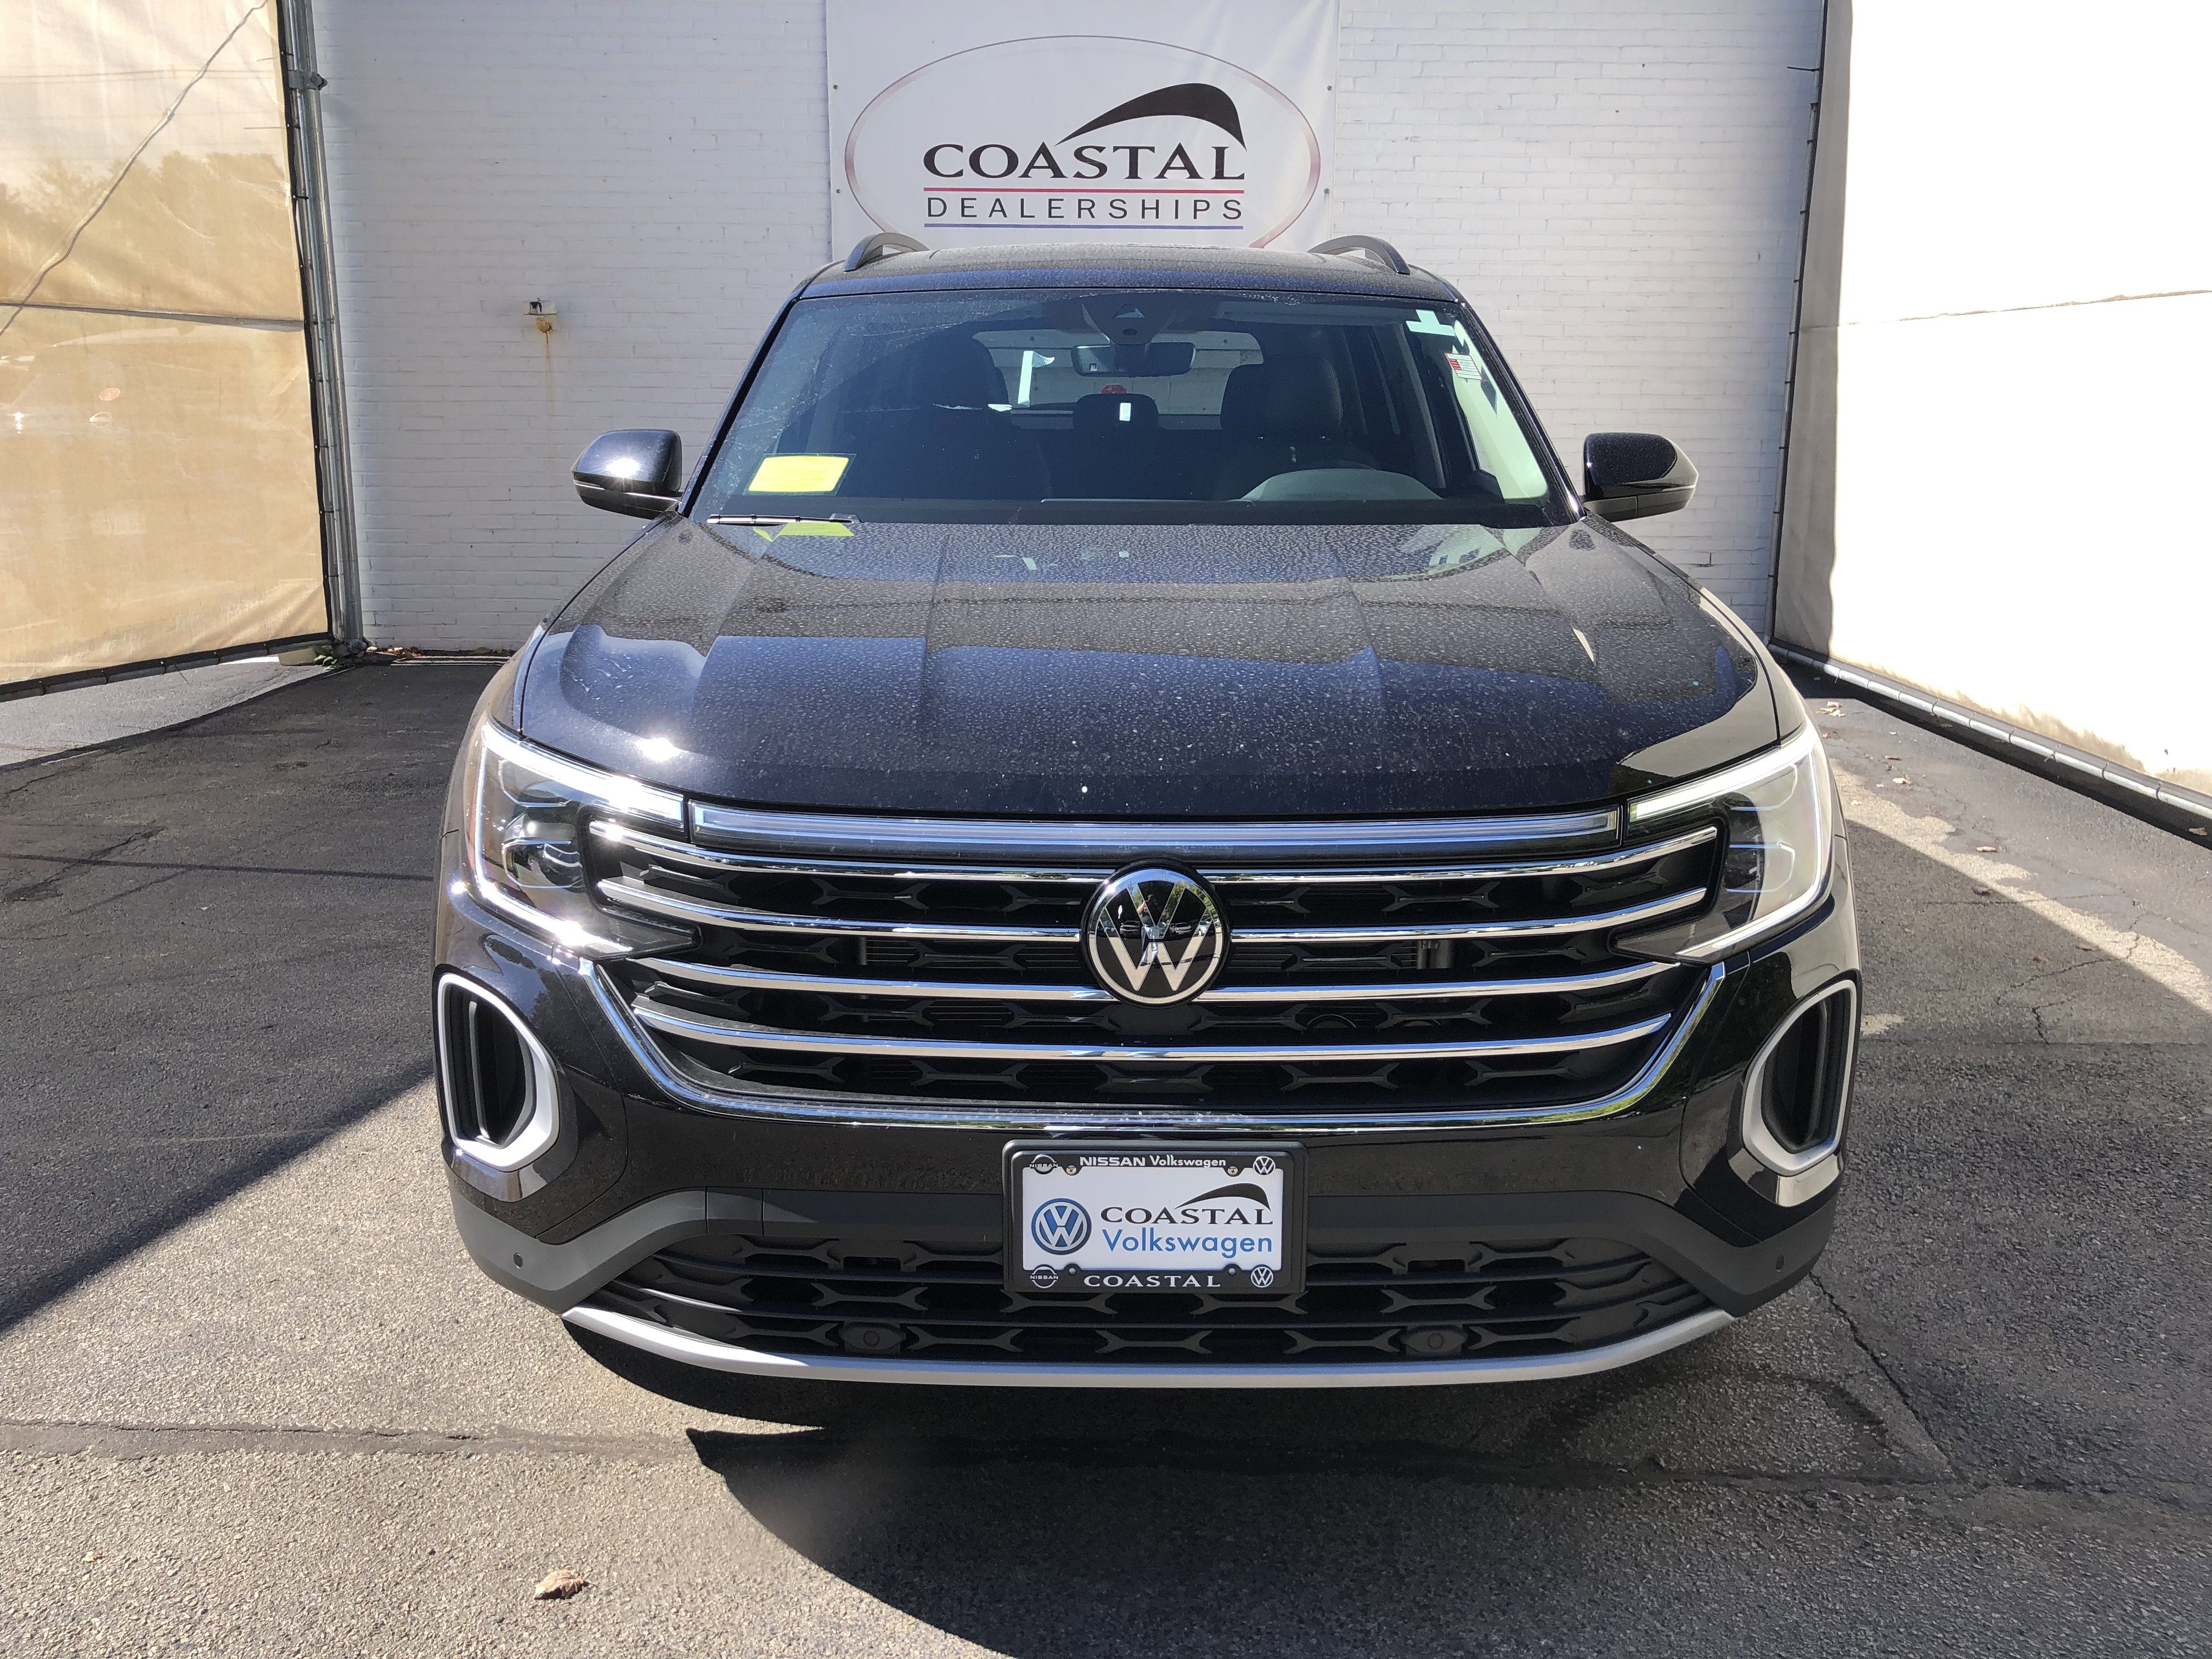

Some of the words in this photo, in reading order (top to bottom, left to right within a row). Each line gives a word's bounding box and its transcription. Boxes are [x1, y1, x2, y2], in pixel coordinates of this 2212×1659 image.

[923, 141, 1245, 180] COASTAL
[927, 197, 1242, 220] DEALERSHIPS
[1080, 1156, 1146, 1166] NISSAN
[1149, 1155, 1226, 1168] Volkswagen
[1101, 1206, 1273, 1225] COASTAL
[1102, 1227, 1272, 1259] Volkswagen
[1084, 1274, 1221, 1288] COASTAL
